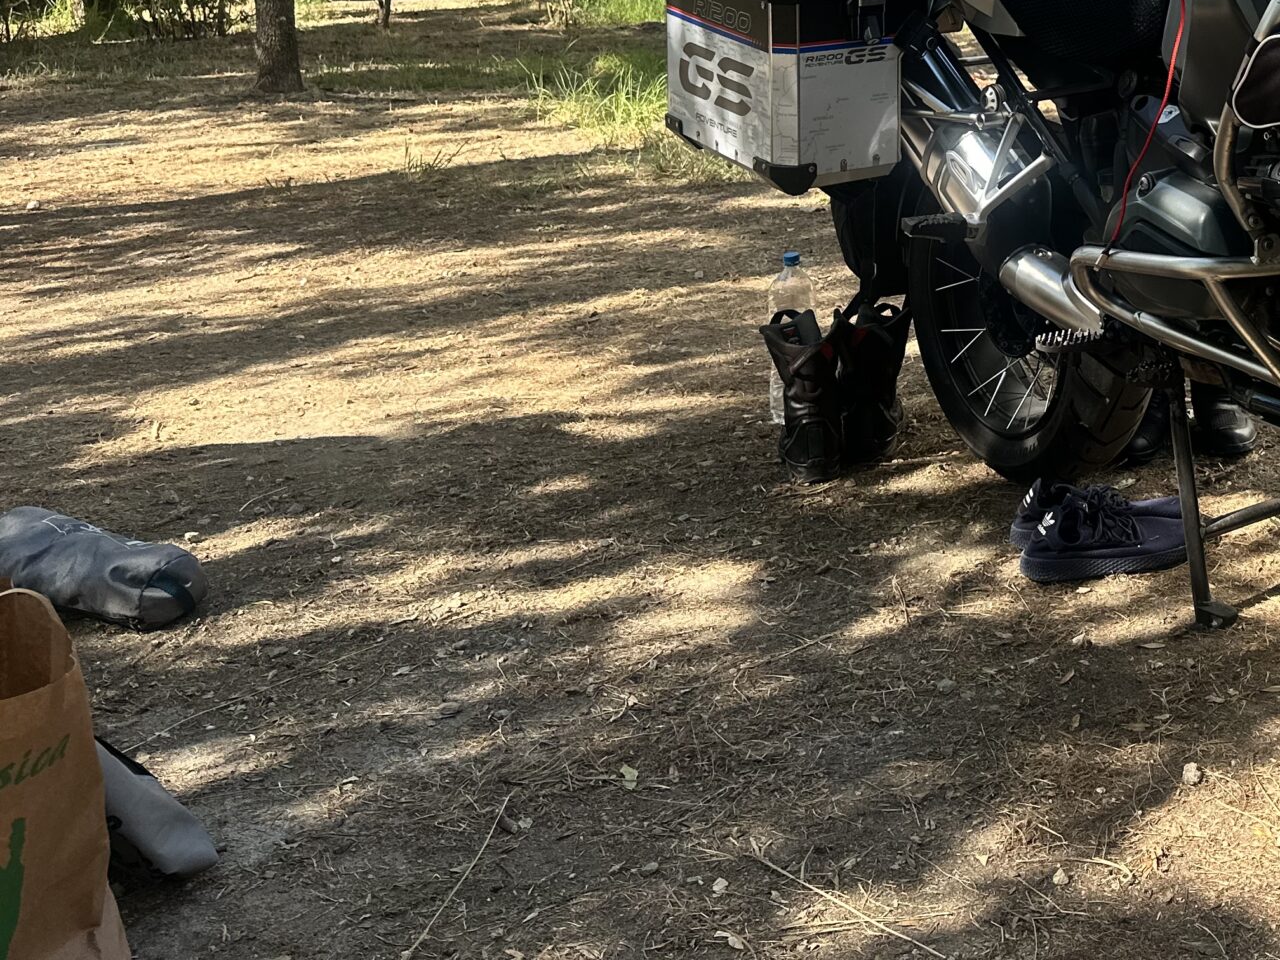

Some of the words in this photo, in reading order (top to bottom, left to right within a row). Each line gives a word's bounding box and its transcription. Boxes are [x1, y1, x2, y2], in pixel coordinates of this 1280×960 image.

[805, 53, 844, 63] R1200
[844, 45, 888, 65] GS
[679, 42, 755, 116] GS
[696, 112, 738, 137] ADVENTURE
